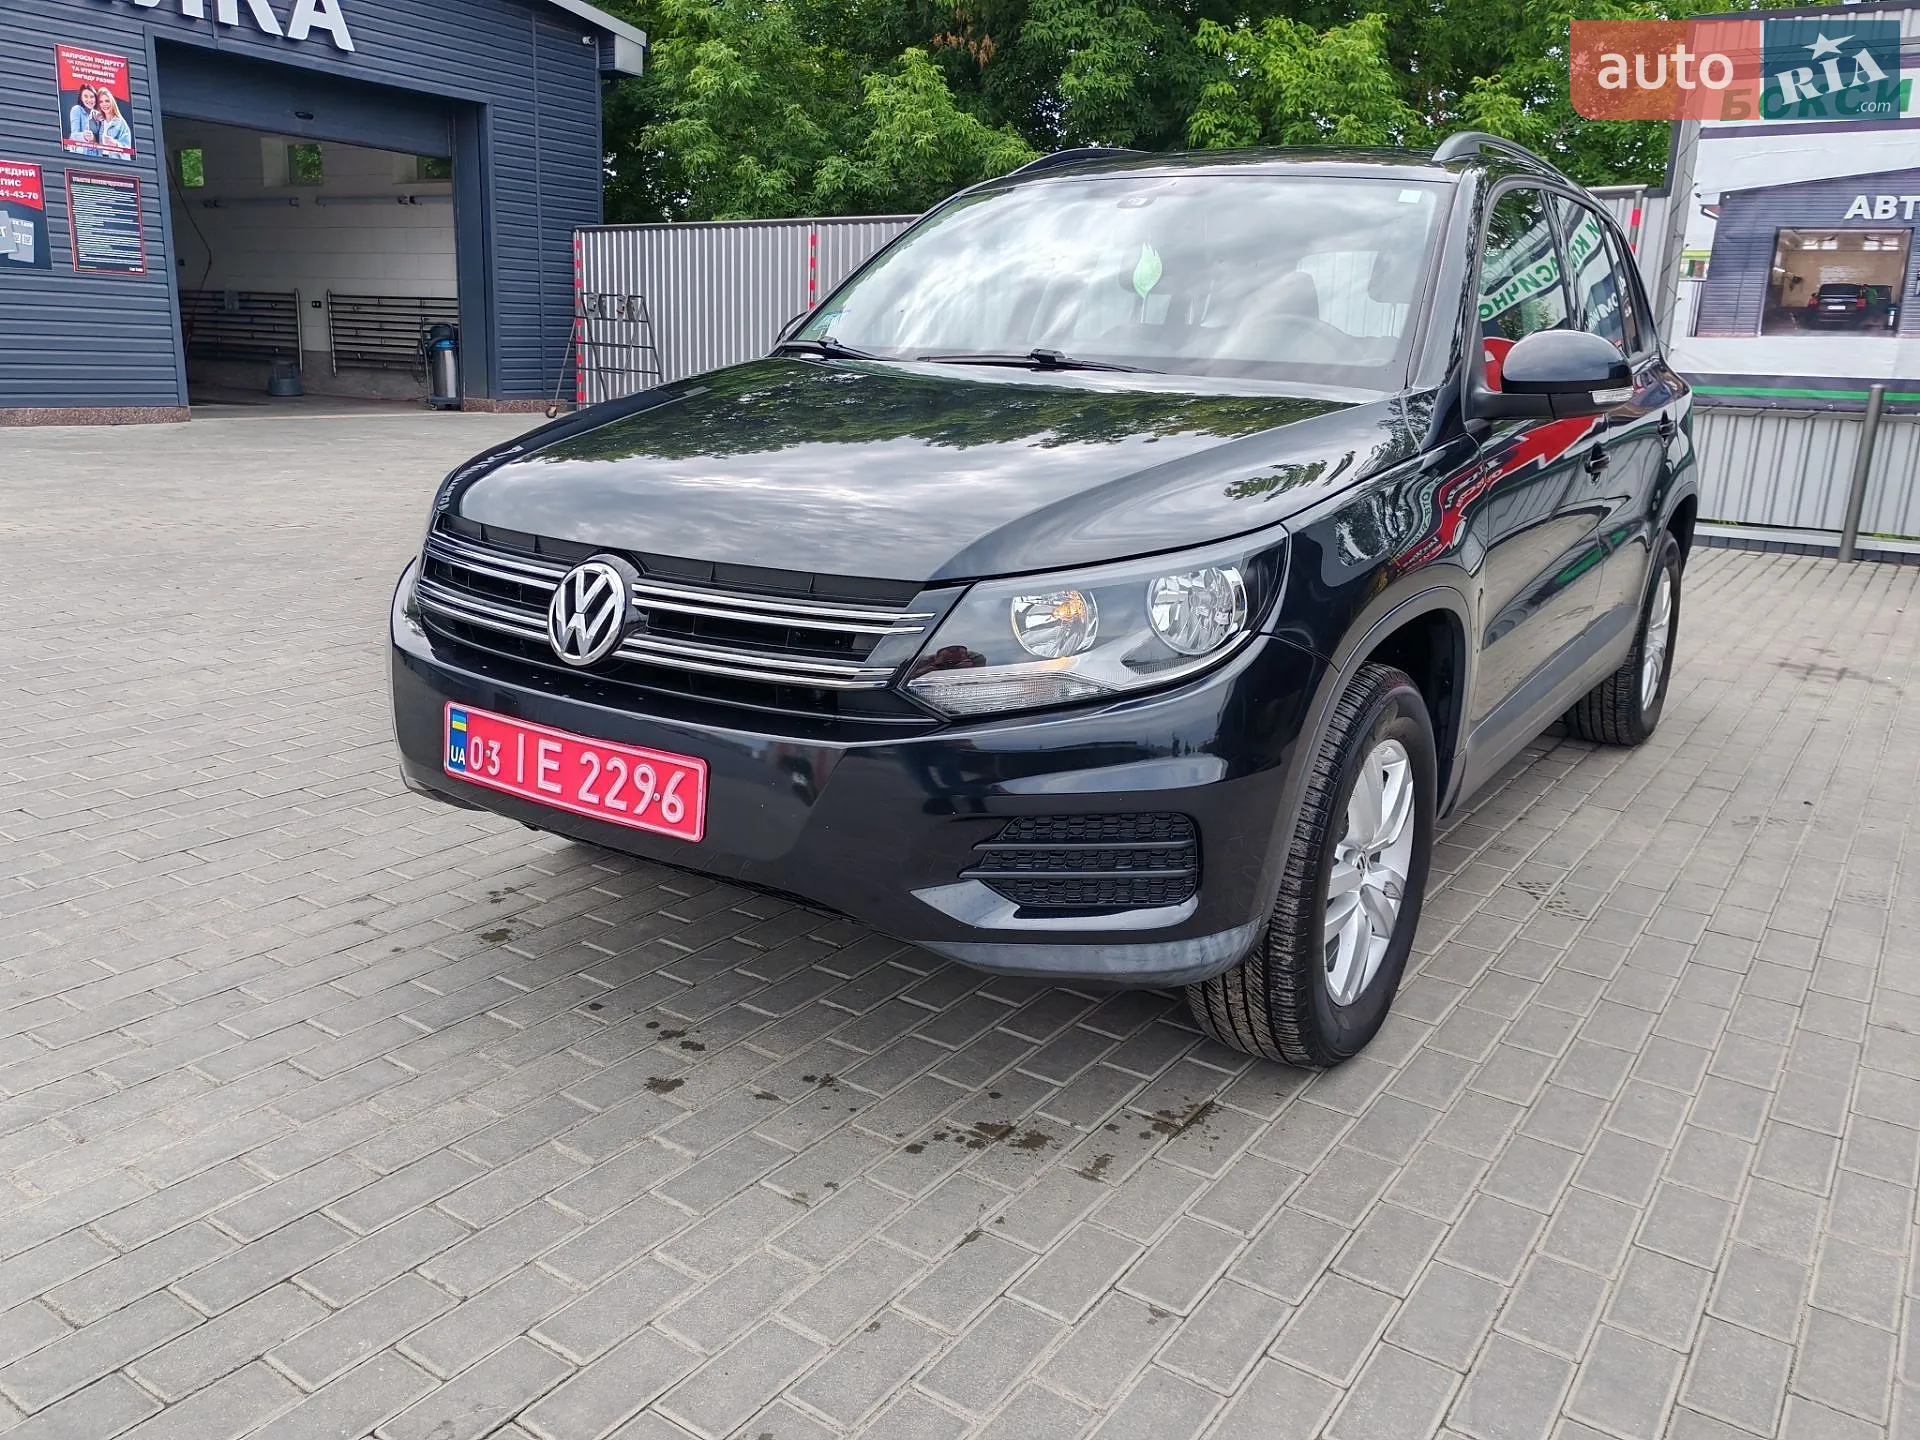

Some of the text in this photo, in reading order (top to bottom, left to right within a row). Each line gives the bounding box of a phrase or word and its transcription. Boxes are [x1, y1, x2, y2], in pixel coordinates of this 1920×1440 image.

[450, 744, 466, 766] UA
[470, 735, 501, 776] 03
[577, 751, 686, 824] 2296
